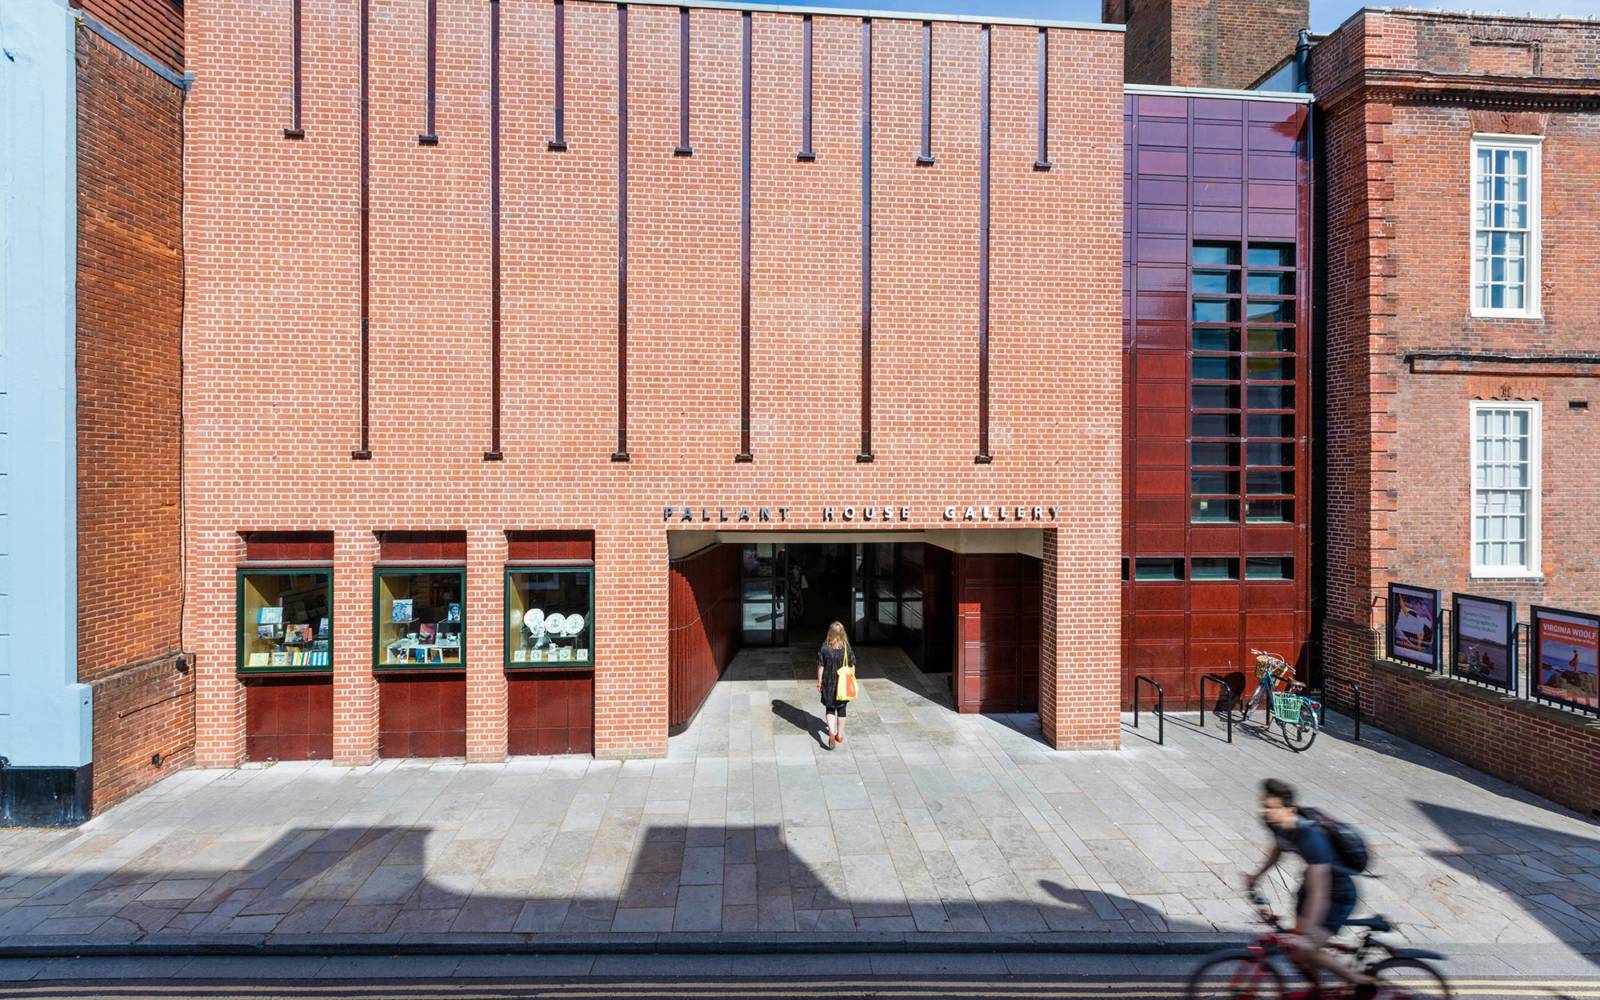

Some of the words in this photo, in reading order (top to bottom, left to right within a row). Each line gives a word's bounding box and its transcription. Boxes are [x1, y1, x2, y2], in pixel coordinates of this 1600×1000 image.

[663, 507, 789, 522] PALLANT
[822, 506, 910, 522] HOUSE
[943, 505, 1060, 521] GALLERY
[1543, 624, 1571, 635] VIRGINIA
[1572, 628, 1597, 640] WOOLF
